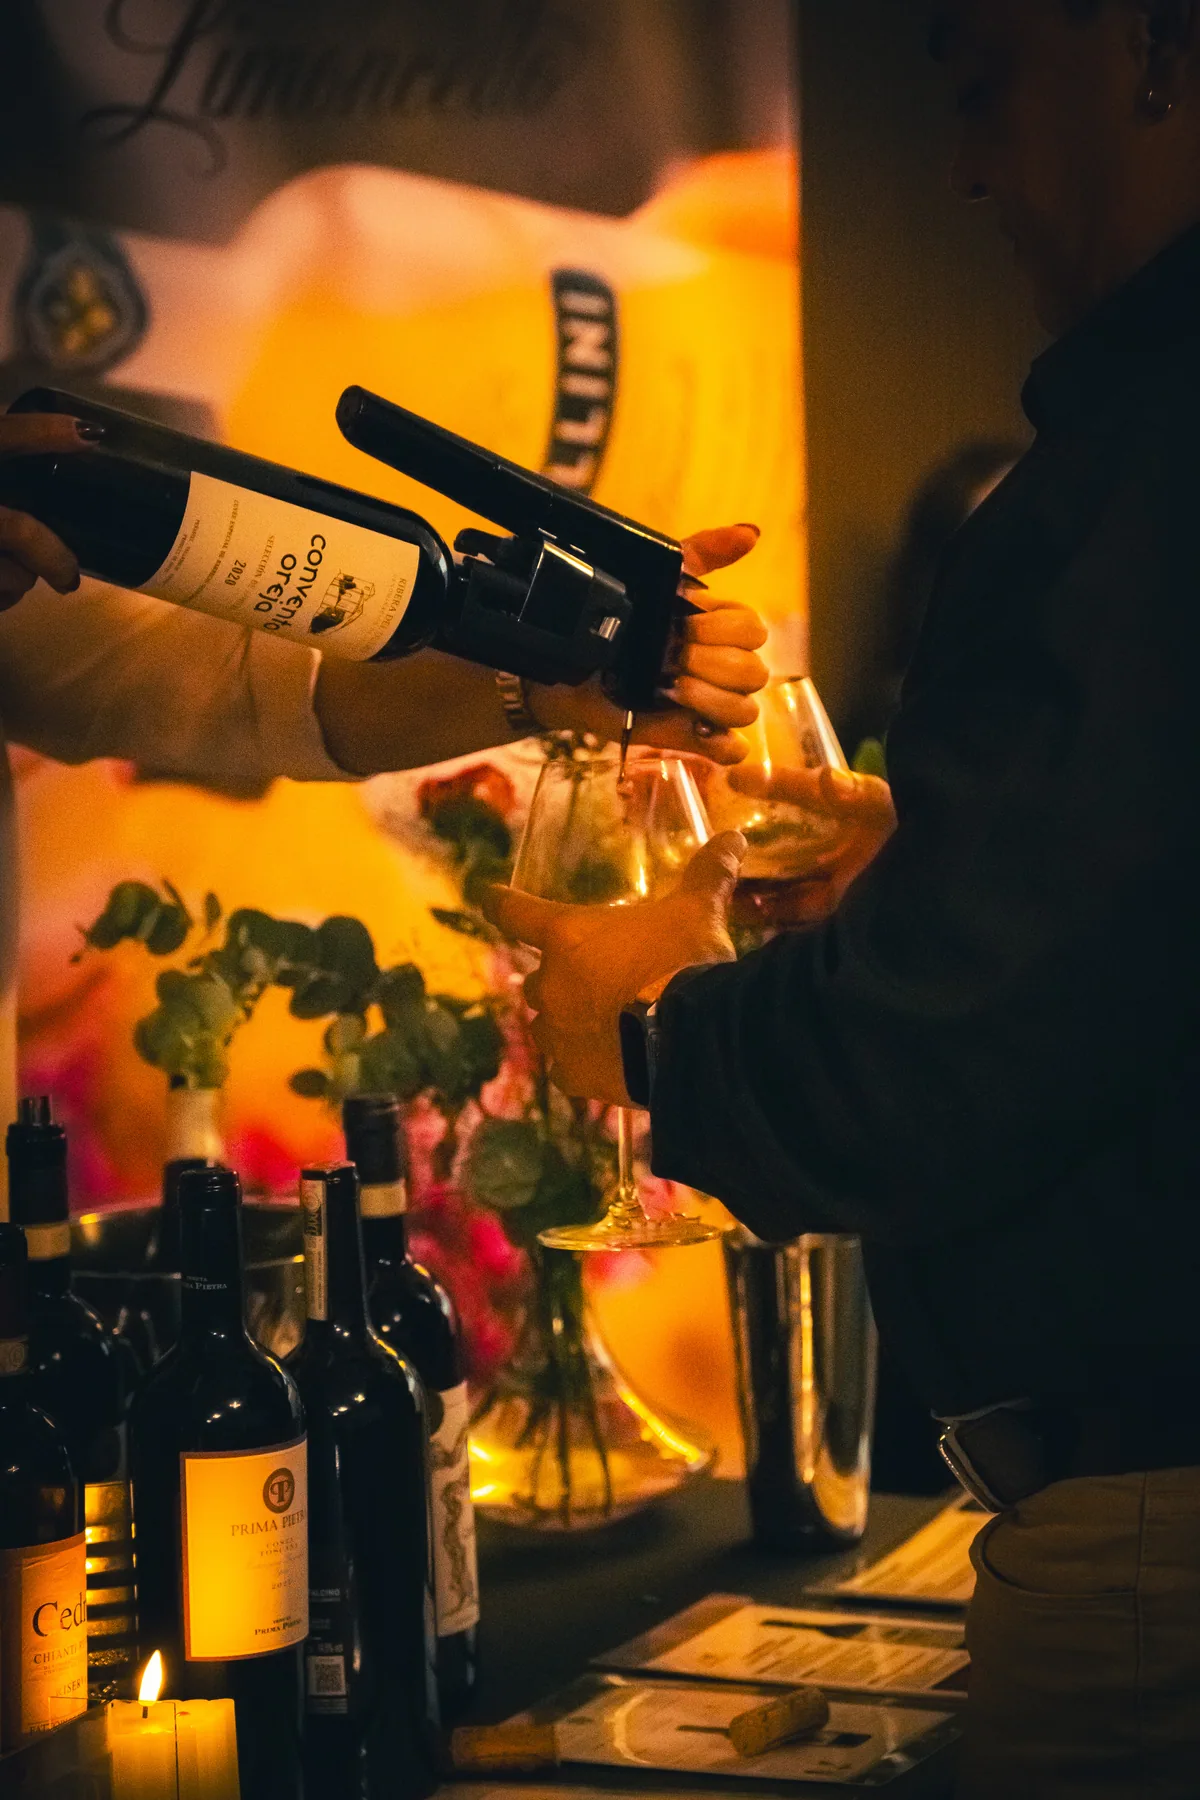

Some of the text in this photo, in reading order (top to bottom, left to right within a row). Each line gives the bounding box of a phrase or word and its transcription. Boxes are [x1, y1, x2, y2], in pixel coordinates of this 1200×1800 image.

[255, 535, 275, 578] SELECCIÓN
[224, 559, 247, 586] 2020
[254, 553, 297, 612] oreja
[263, 534, 326, 630] convento
[389, 578, 407, 611] RIBERA
[195, 1282, 228, 1290] PIETRA
[230, 1519, 278, 1536] PRIMA
[254, 1626, 281, 1635] PRIMA
[33, 1644, 77, 1664] CHIANTI
